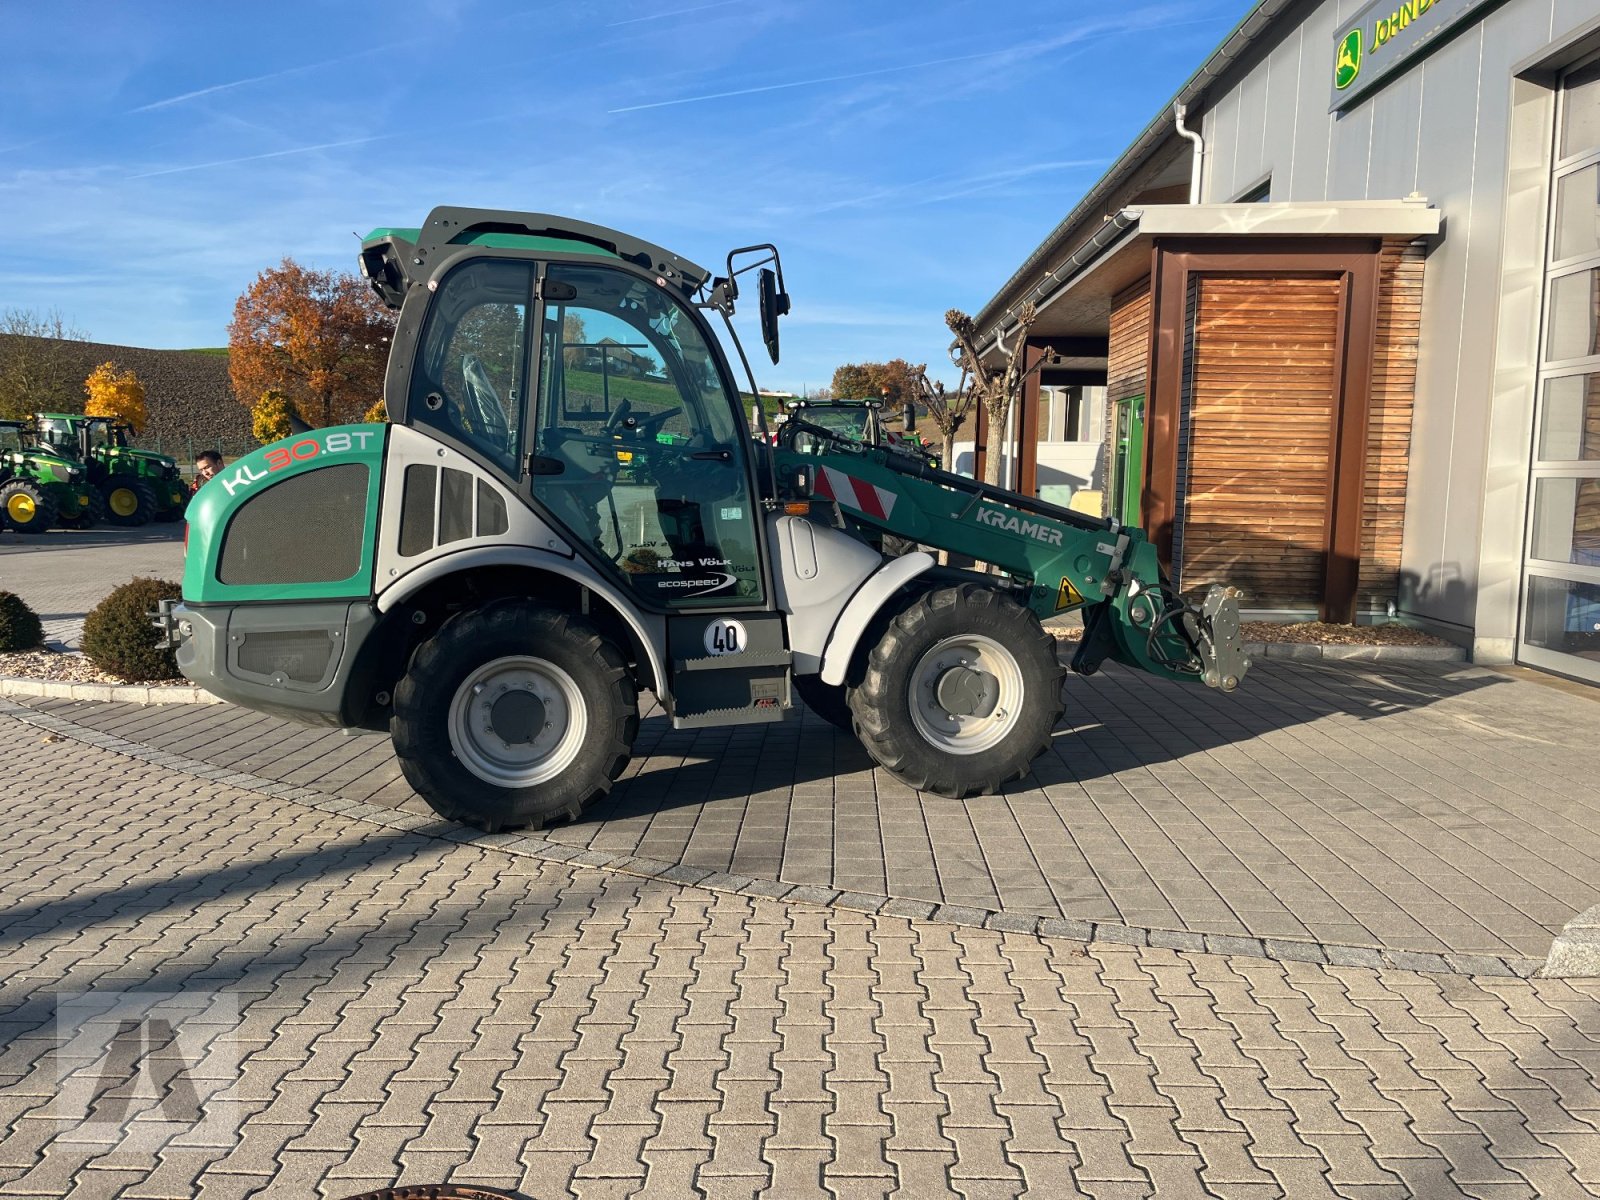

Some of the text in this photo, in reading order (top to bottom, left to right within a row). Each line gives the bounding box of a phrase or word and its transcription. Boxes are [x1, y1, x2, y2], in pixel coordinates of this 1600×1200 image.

[1368, 0, 1418, 54] JOHN
[221, 432, 375, 496] KL30.8T
[976, 506, 1063, 546] KRAMER
[657, 578, 719, 588] ecospeed
[713, 625, 738, 653] 40
